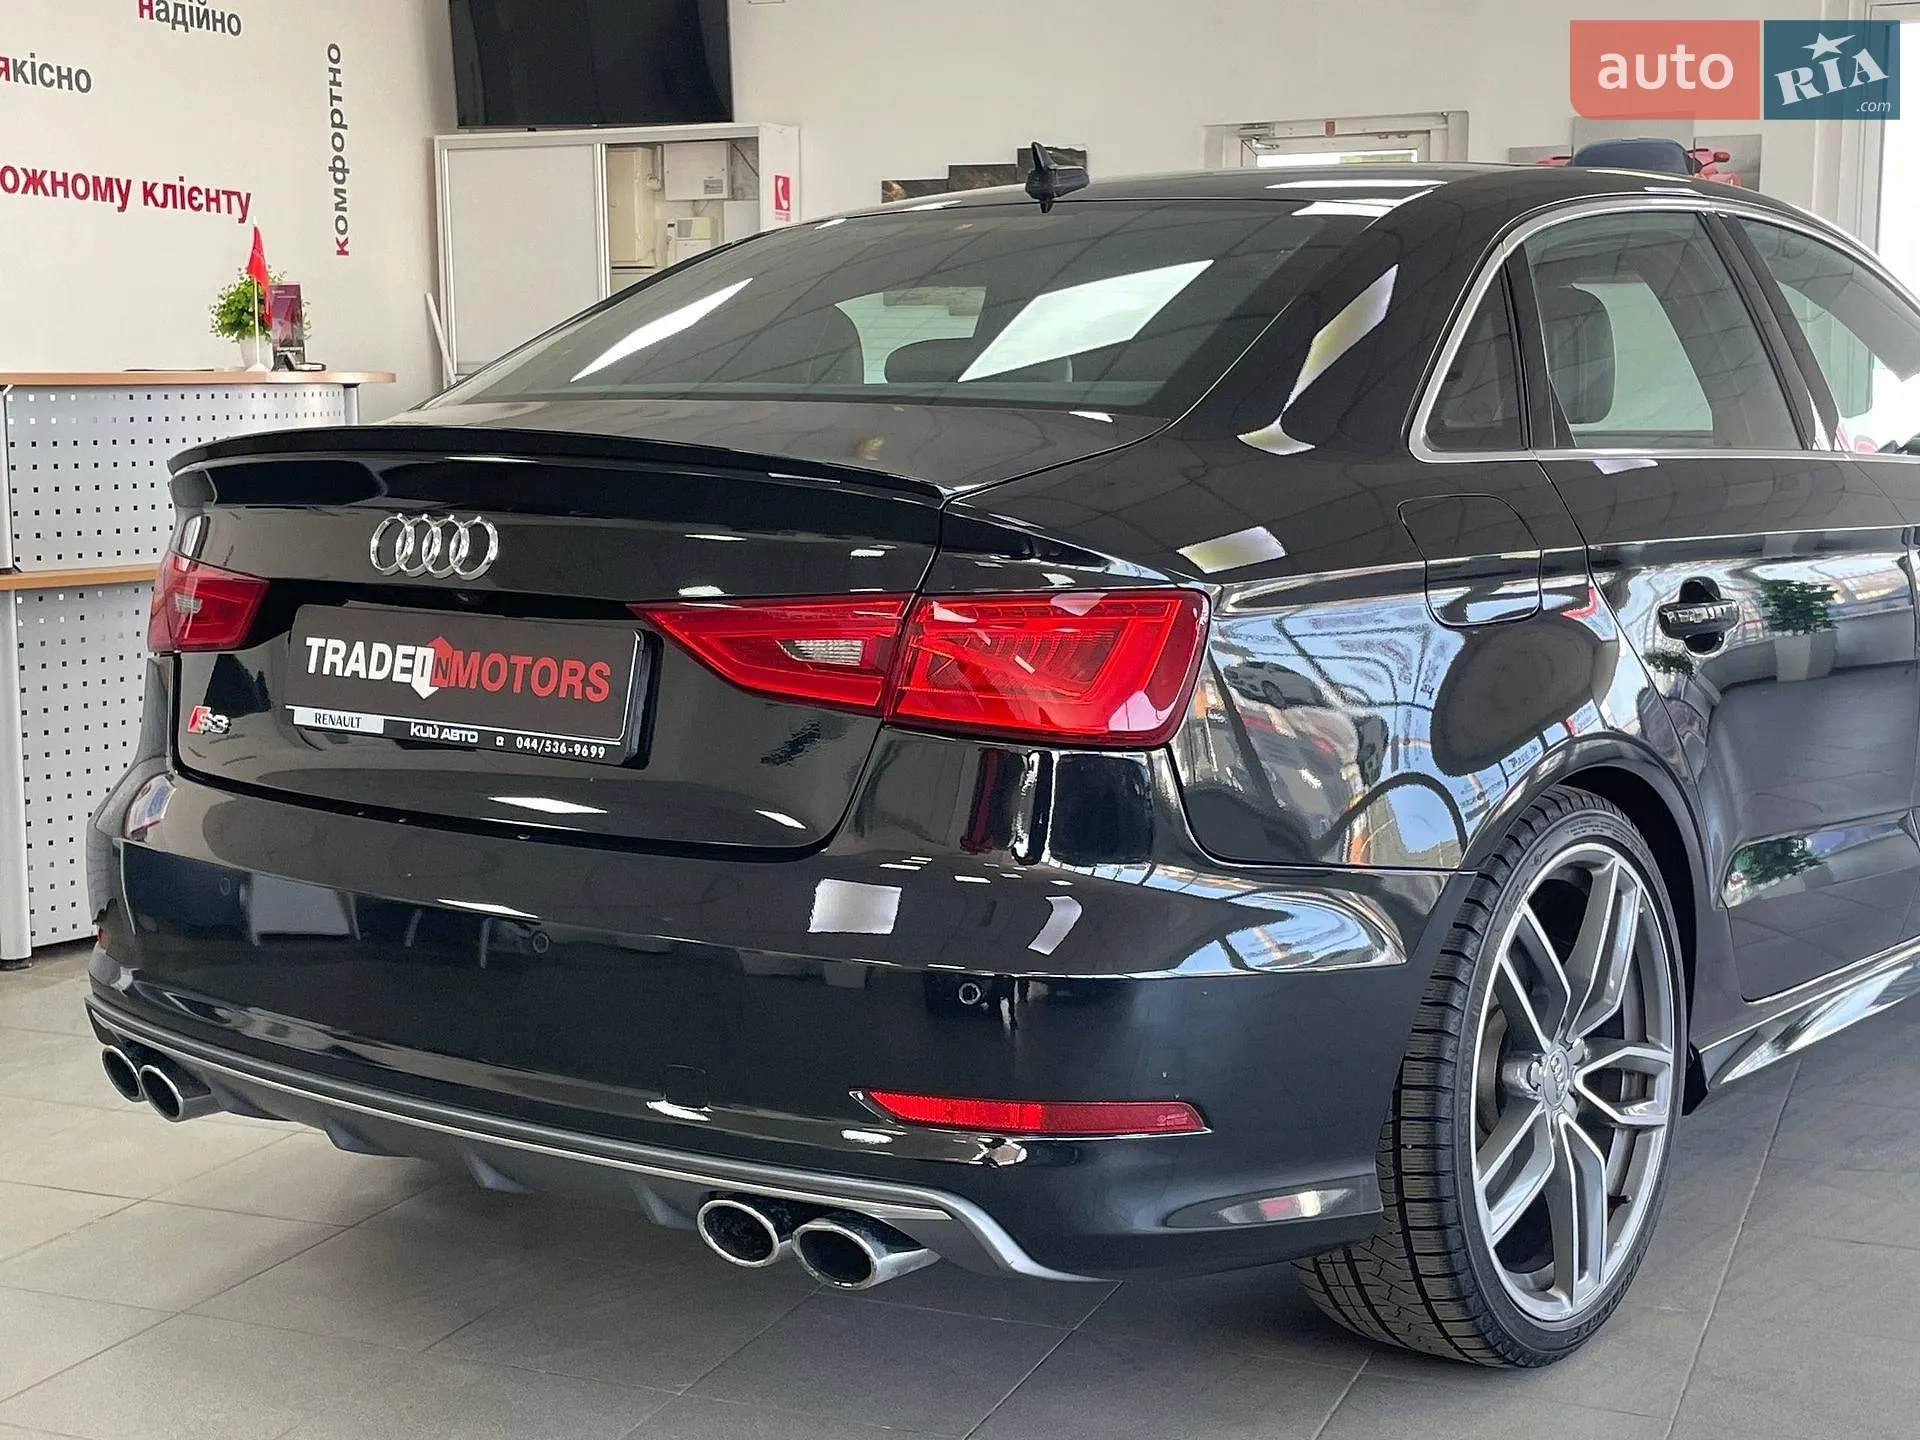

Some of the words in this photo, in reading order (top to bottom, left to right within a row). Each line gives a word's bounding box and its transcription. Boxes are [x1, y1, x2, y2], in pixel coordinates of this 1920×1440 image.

[138, 0, 242, 36] надійно
[327, 43, 350, 256] комфортно
[142, 176, 252, 224] клієнту
[314, 712, 362, 729] RENAULT
[516, 737, 606, 759] 044/536-9699
